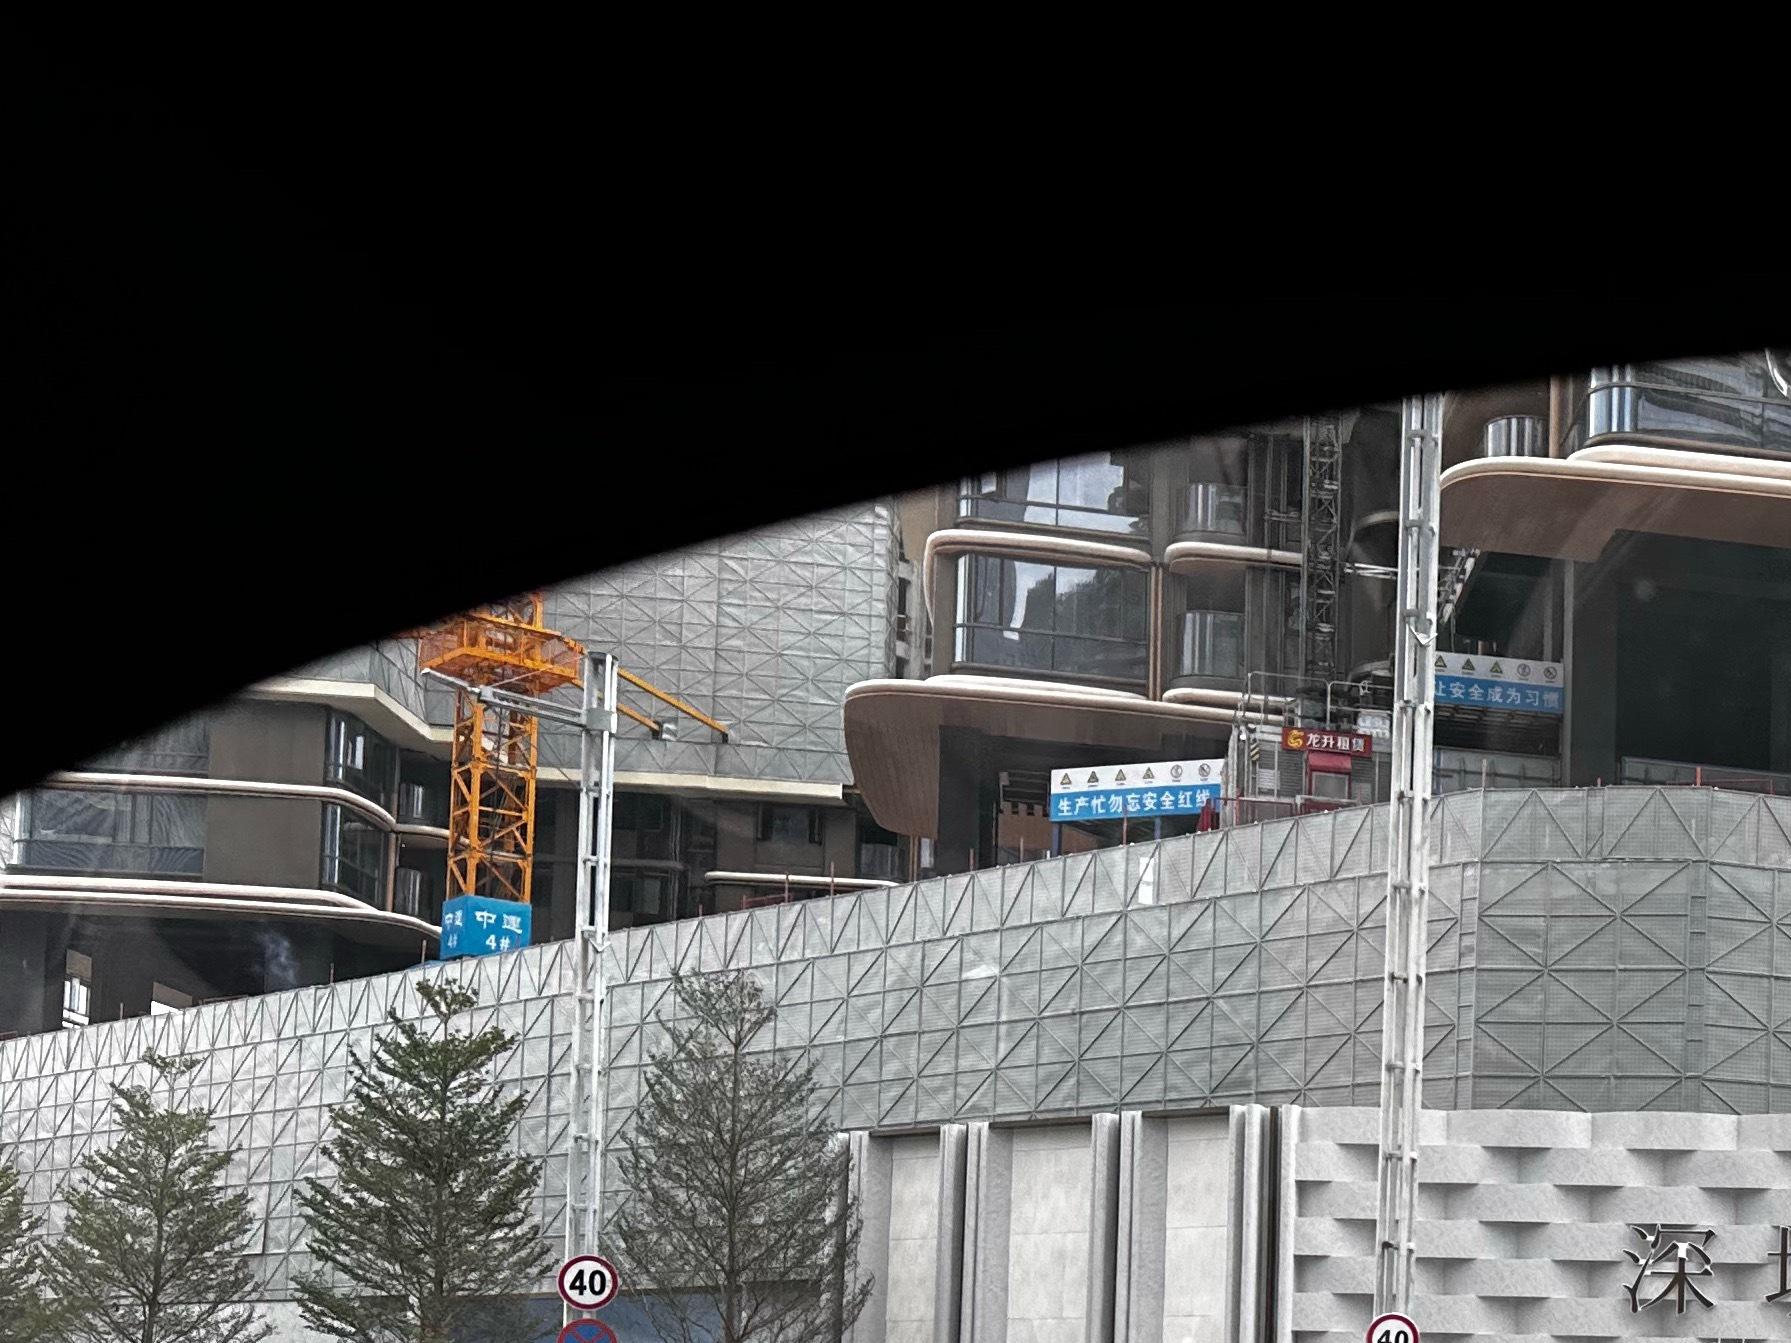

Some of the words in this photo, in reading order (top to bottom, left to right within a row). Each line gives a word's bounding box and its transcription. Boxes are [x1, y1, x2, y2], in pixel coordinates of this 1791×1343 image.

[1058, 788, 1211, 816] 生产忙勿忘安全红线
[569, 1269, 606, 1296] 40
